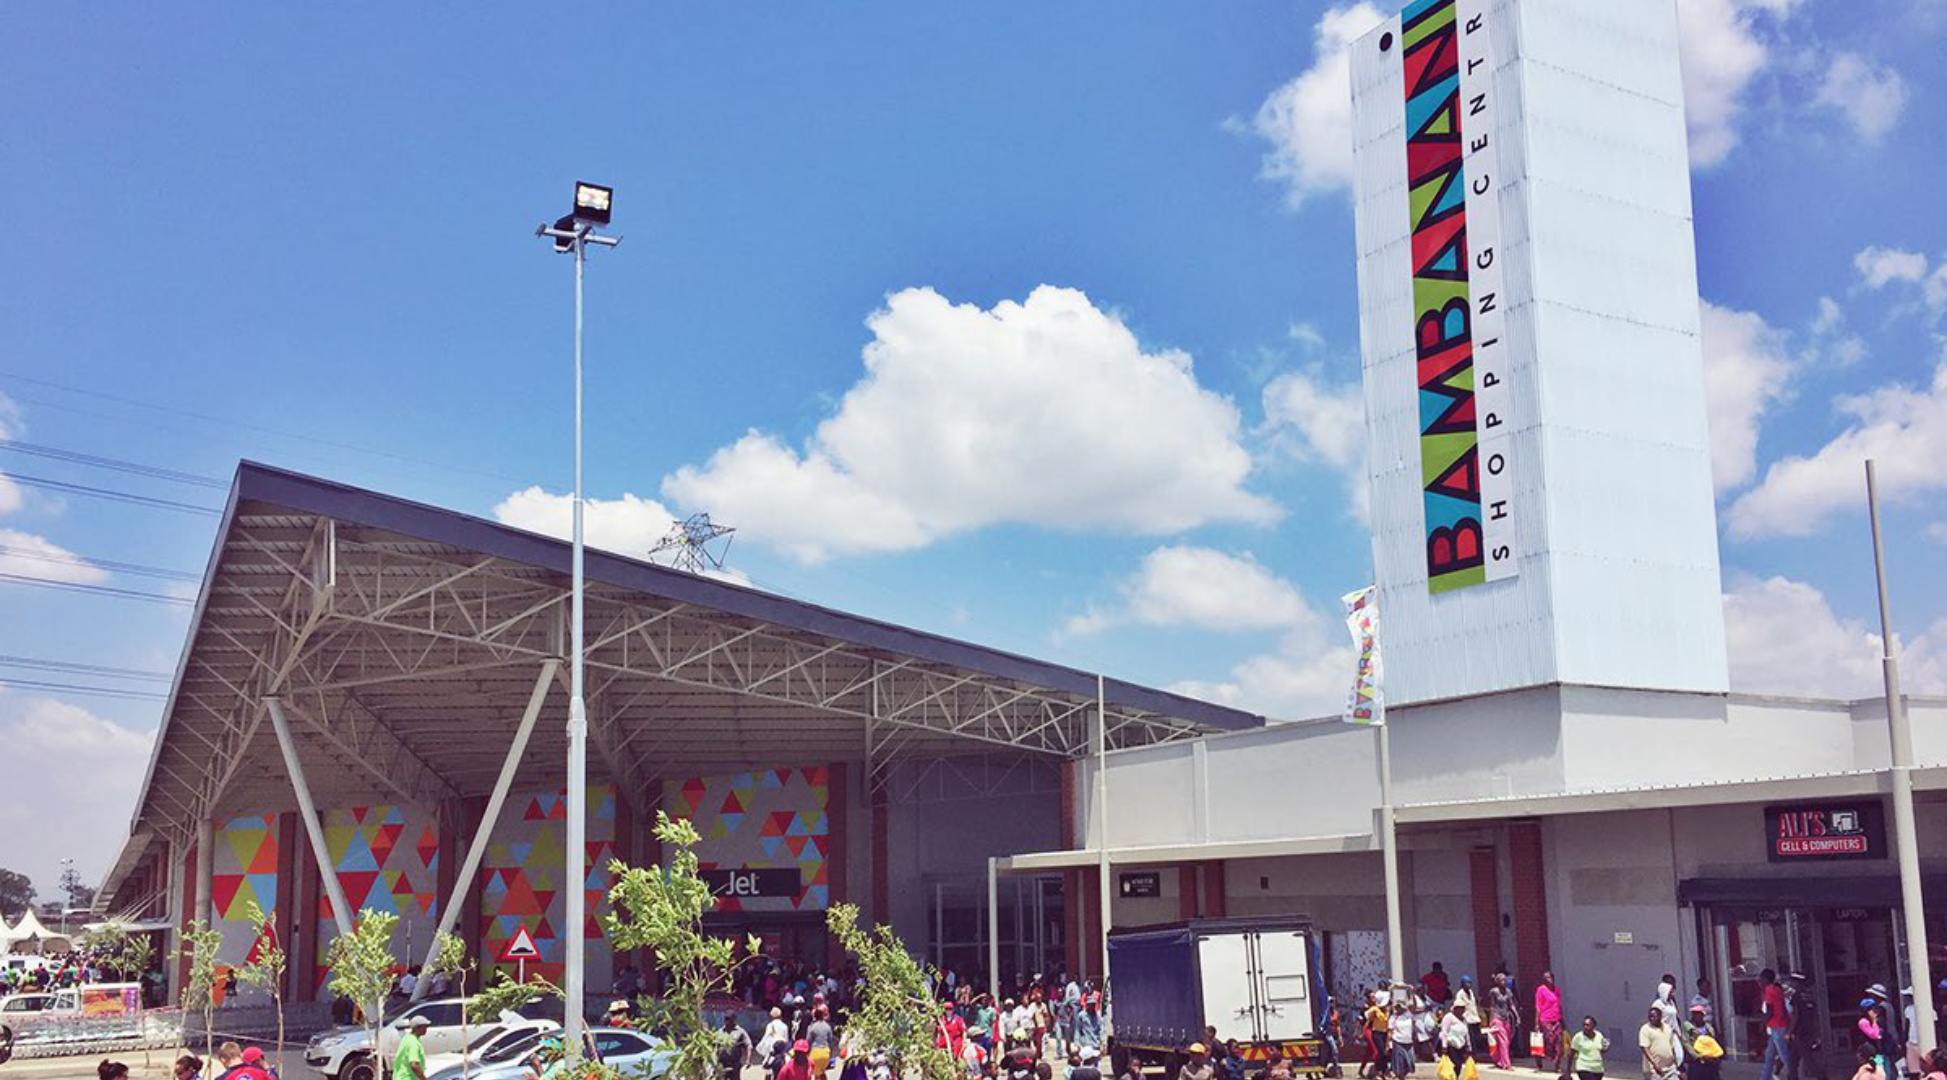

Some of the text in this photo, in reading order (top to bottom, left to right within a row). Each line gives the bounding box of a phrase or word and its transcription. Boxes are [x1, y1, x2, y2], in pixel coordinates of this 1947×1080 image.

[1401, 0, 1485, 577] BAMBANANI
[1476, 246, 1510, 561] SHOPPING
[1779, 811, 1826, 837] ALI'S
[1781, 839, 1860, 852] CELL & COMPUTERS
[725, 871, 760, 896] Jet
